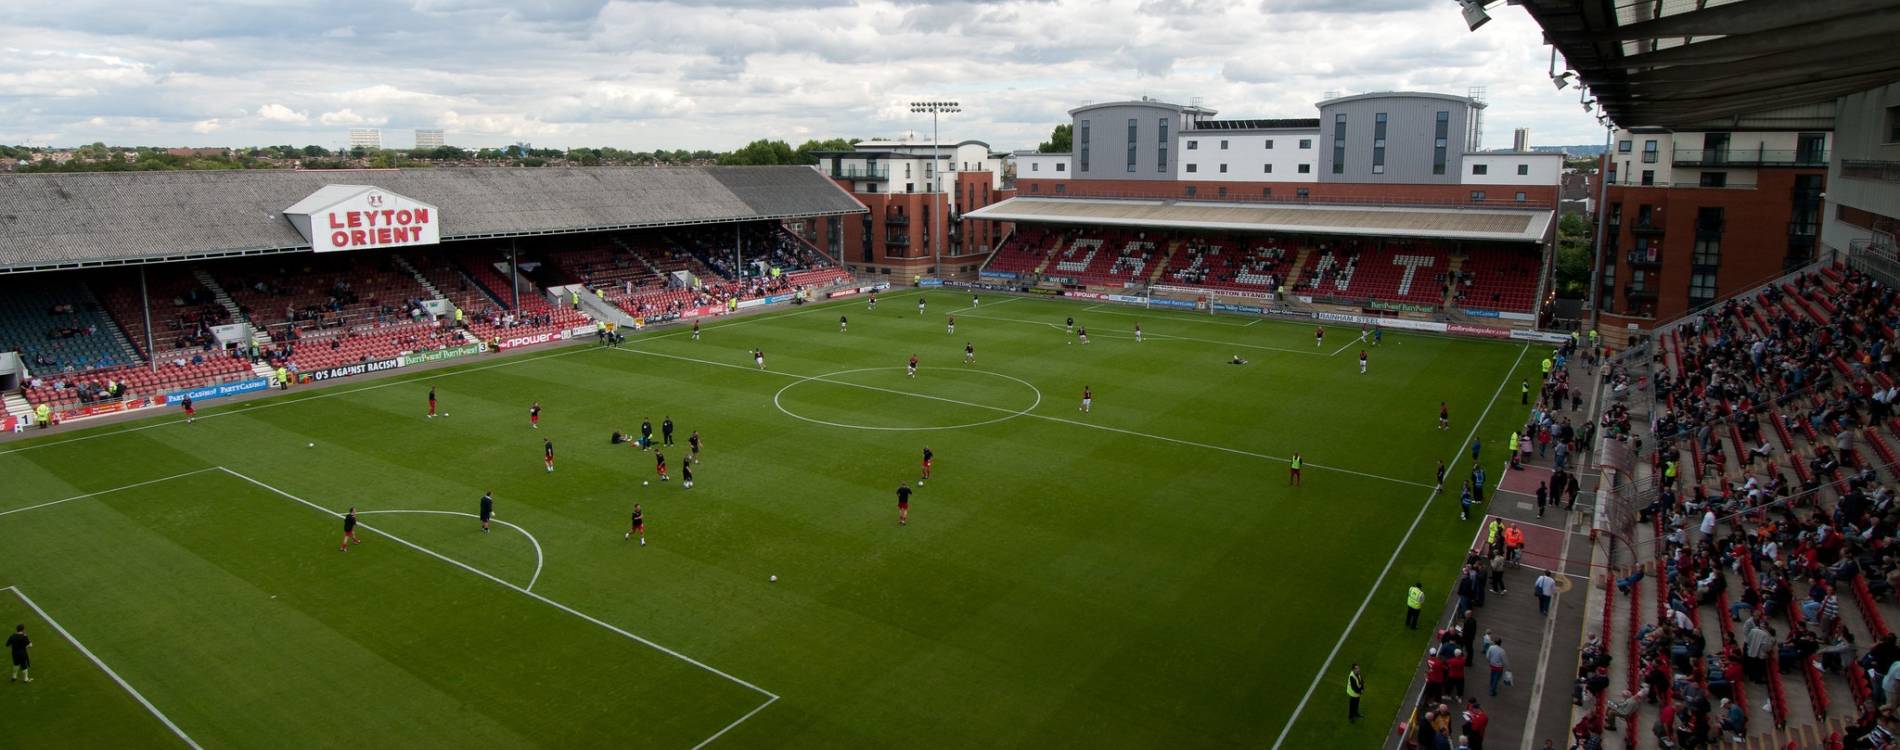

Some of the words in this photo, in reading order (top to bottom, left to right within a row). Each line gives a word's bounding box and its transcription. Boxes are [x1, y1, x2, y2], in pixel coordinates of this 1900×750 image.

[329, 208, 429, 228] LEYTON
[331, 227, 422, 247] ORIENT
[1073, 291, 1098, 299] npower
[1319, 312, 1354, 321] RAINHAM
[1356, 316, 1379, 324] STEEL
[507, 333, 552, 347] npower
[480, 343, 486, 351] 3
[315, 370, 329, 380] O'S
[331, 364, 366, 378] AGAINST
[368, 359, 397, 372] RACISM
[272, 377, 279, 386] 2
[21, 414, 28, 424] 1
